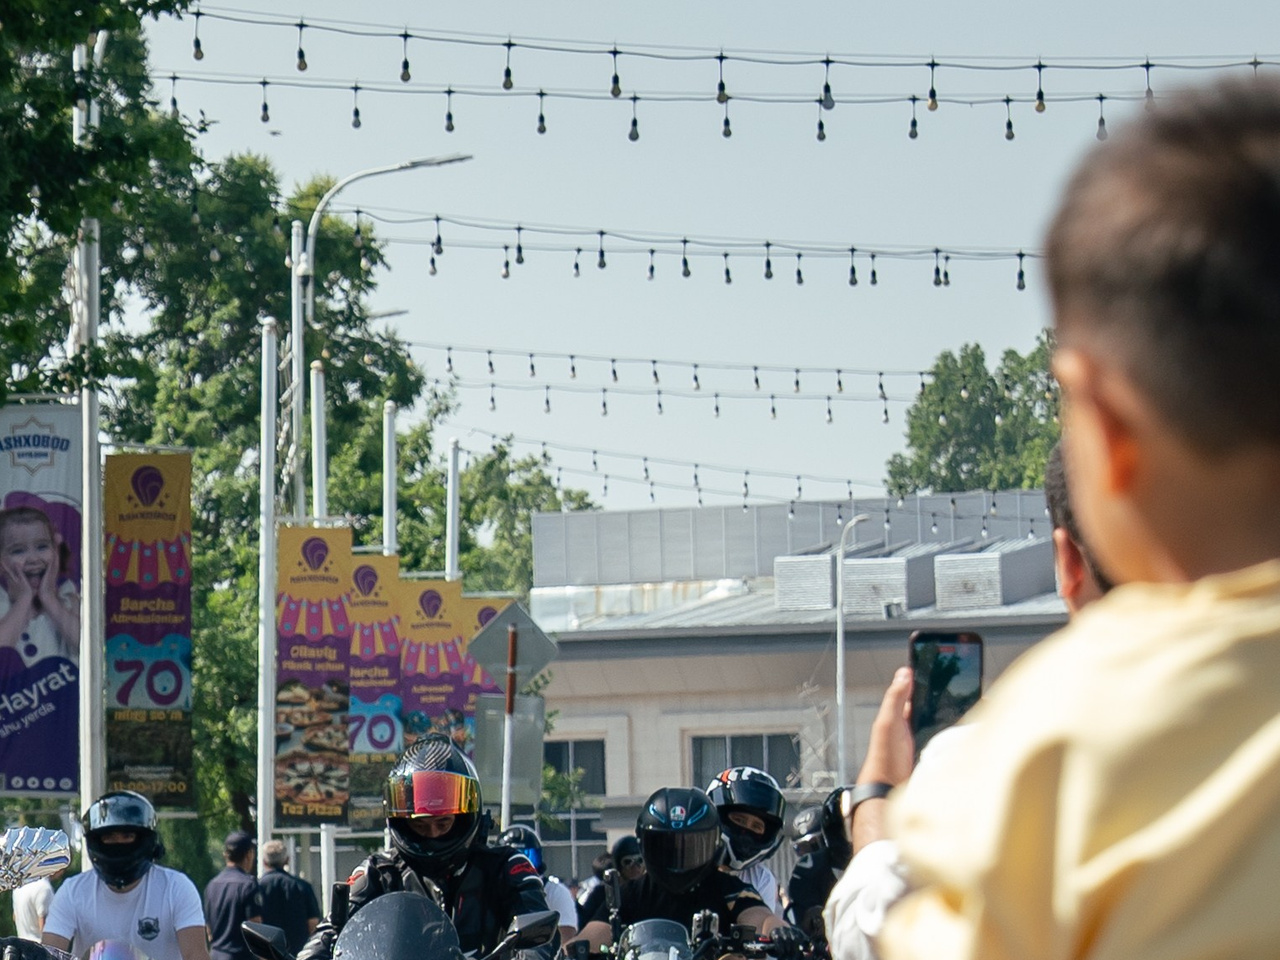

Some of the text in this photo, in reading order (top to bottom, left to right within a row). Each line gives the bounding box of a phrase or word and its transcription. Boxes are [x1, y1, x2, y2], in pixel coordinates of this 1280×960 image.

[114, 658, 183, 706] 70
[21, 702, 56, 728] yerda
[348, 714, 396, 750] 70
